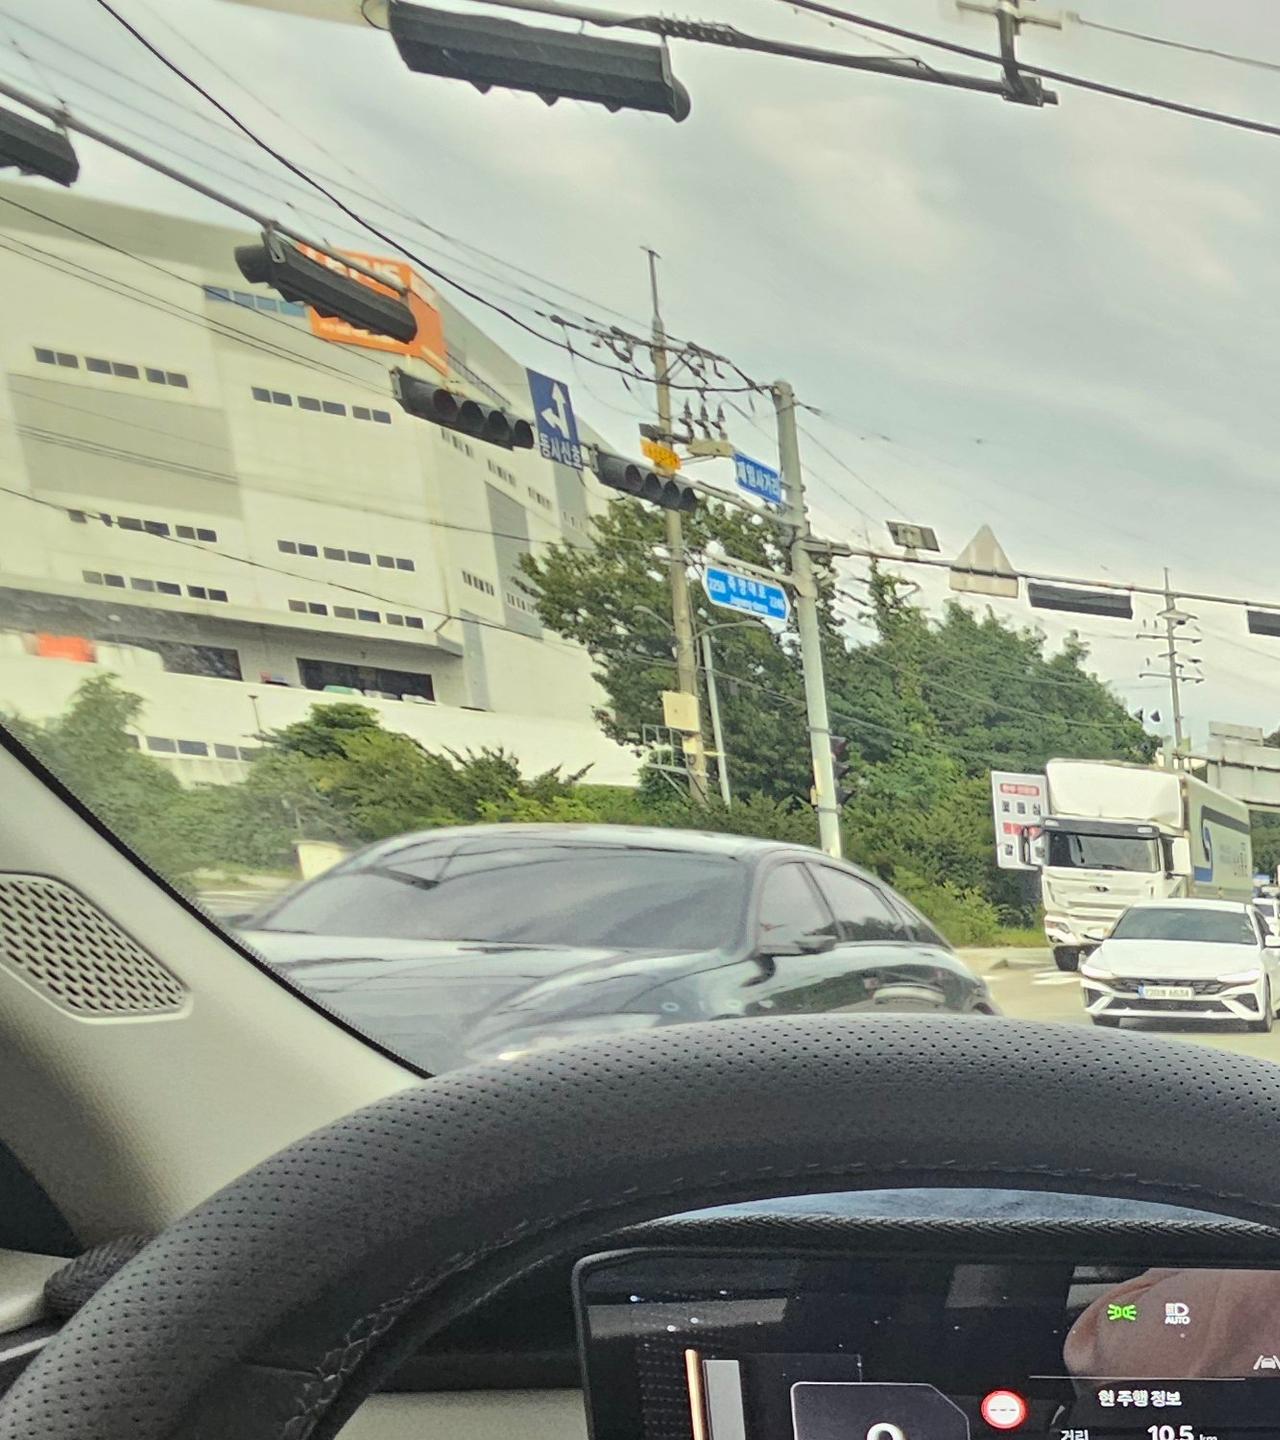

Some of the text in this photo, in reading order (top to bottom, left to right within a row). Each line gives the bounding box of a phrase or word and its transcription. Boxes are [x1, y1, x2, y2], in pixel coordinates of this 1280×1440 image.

[539, 433, 584, 471] 동시신호
[1164, 1315, 1191, 1325] AUTO
[1098, 1389, 1182, 1407] 현 주행 정보
